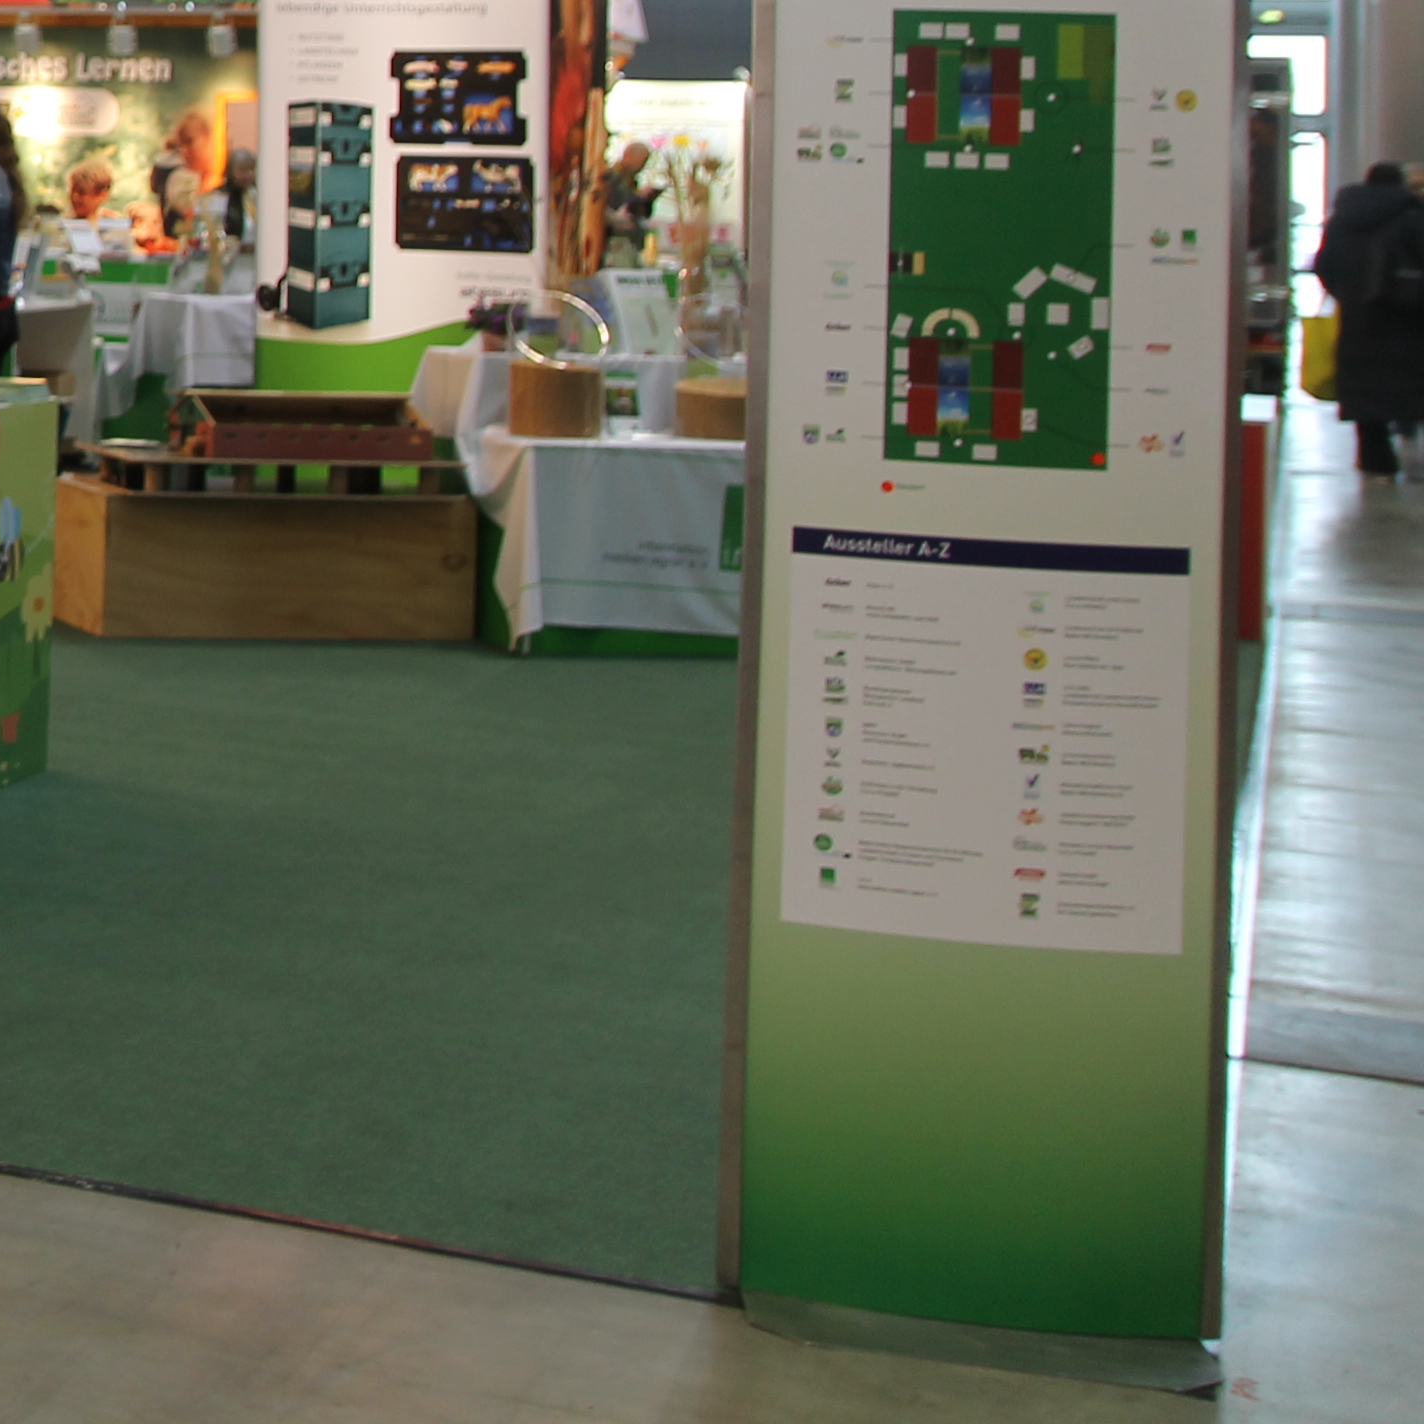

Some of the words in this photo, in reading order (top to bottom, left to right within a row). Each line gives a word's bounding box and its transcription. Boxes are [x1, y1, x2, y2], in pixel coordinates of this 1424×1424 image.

[75, 51, 173, 83] Lernen
[823, 533, 915, 556] Aussteller
[917, 541, 952, 559] A-Z
